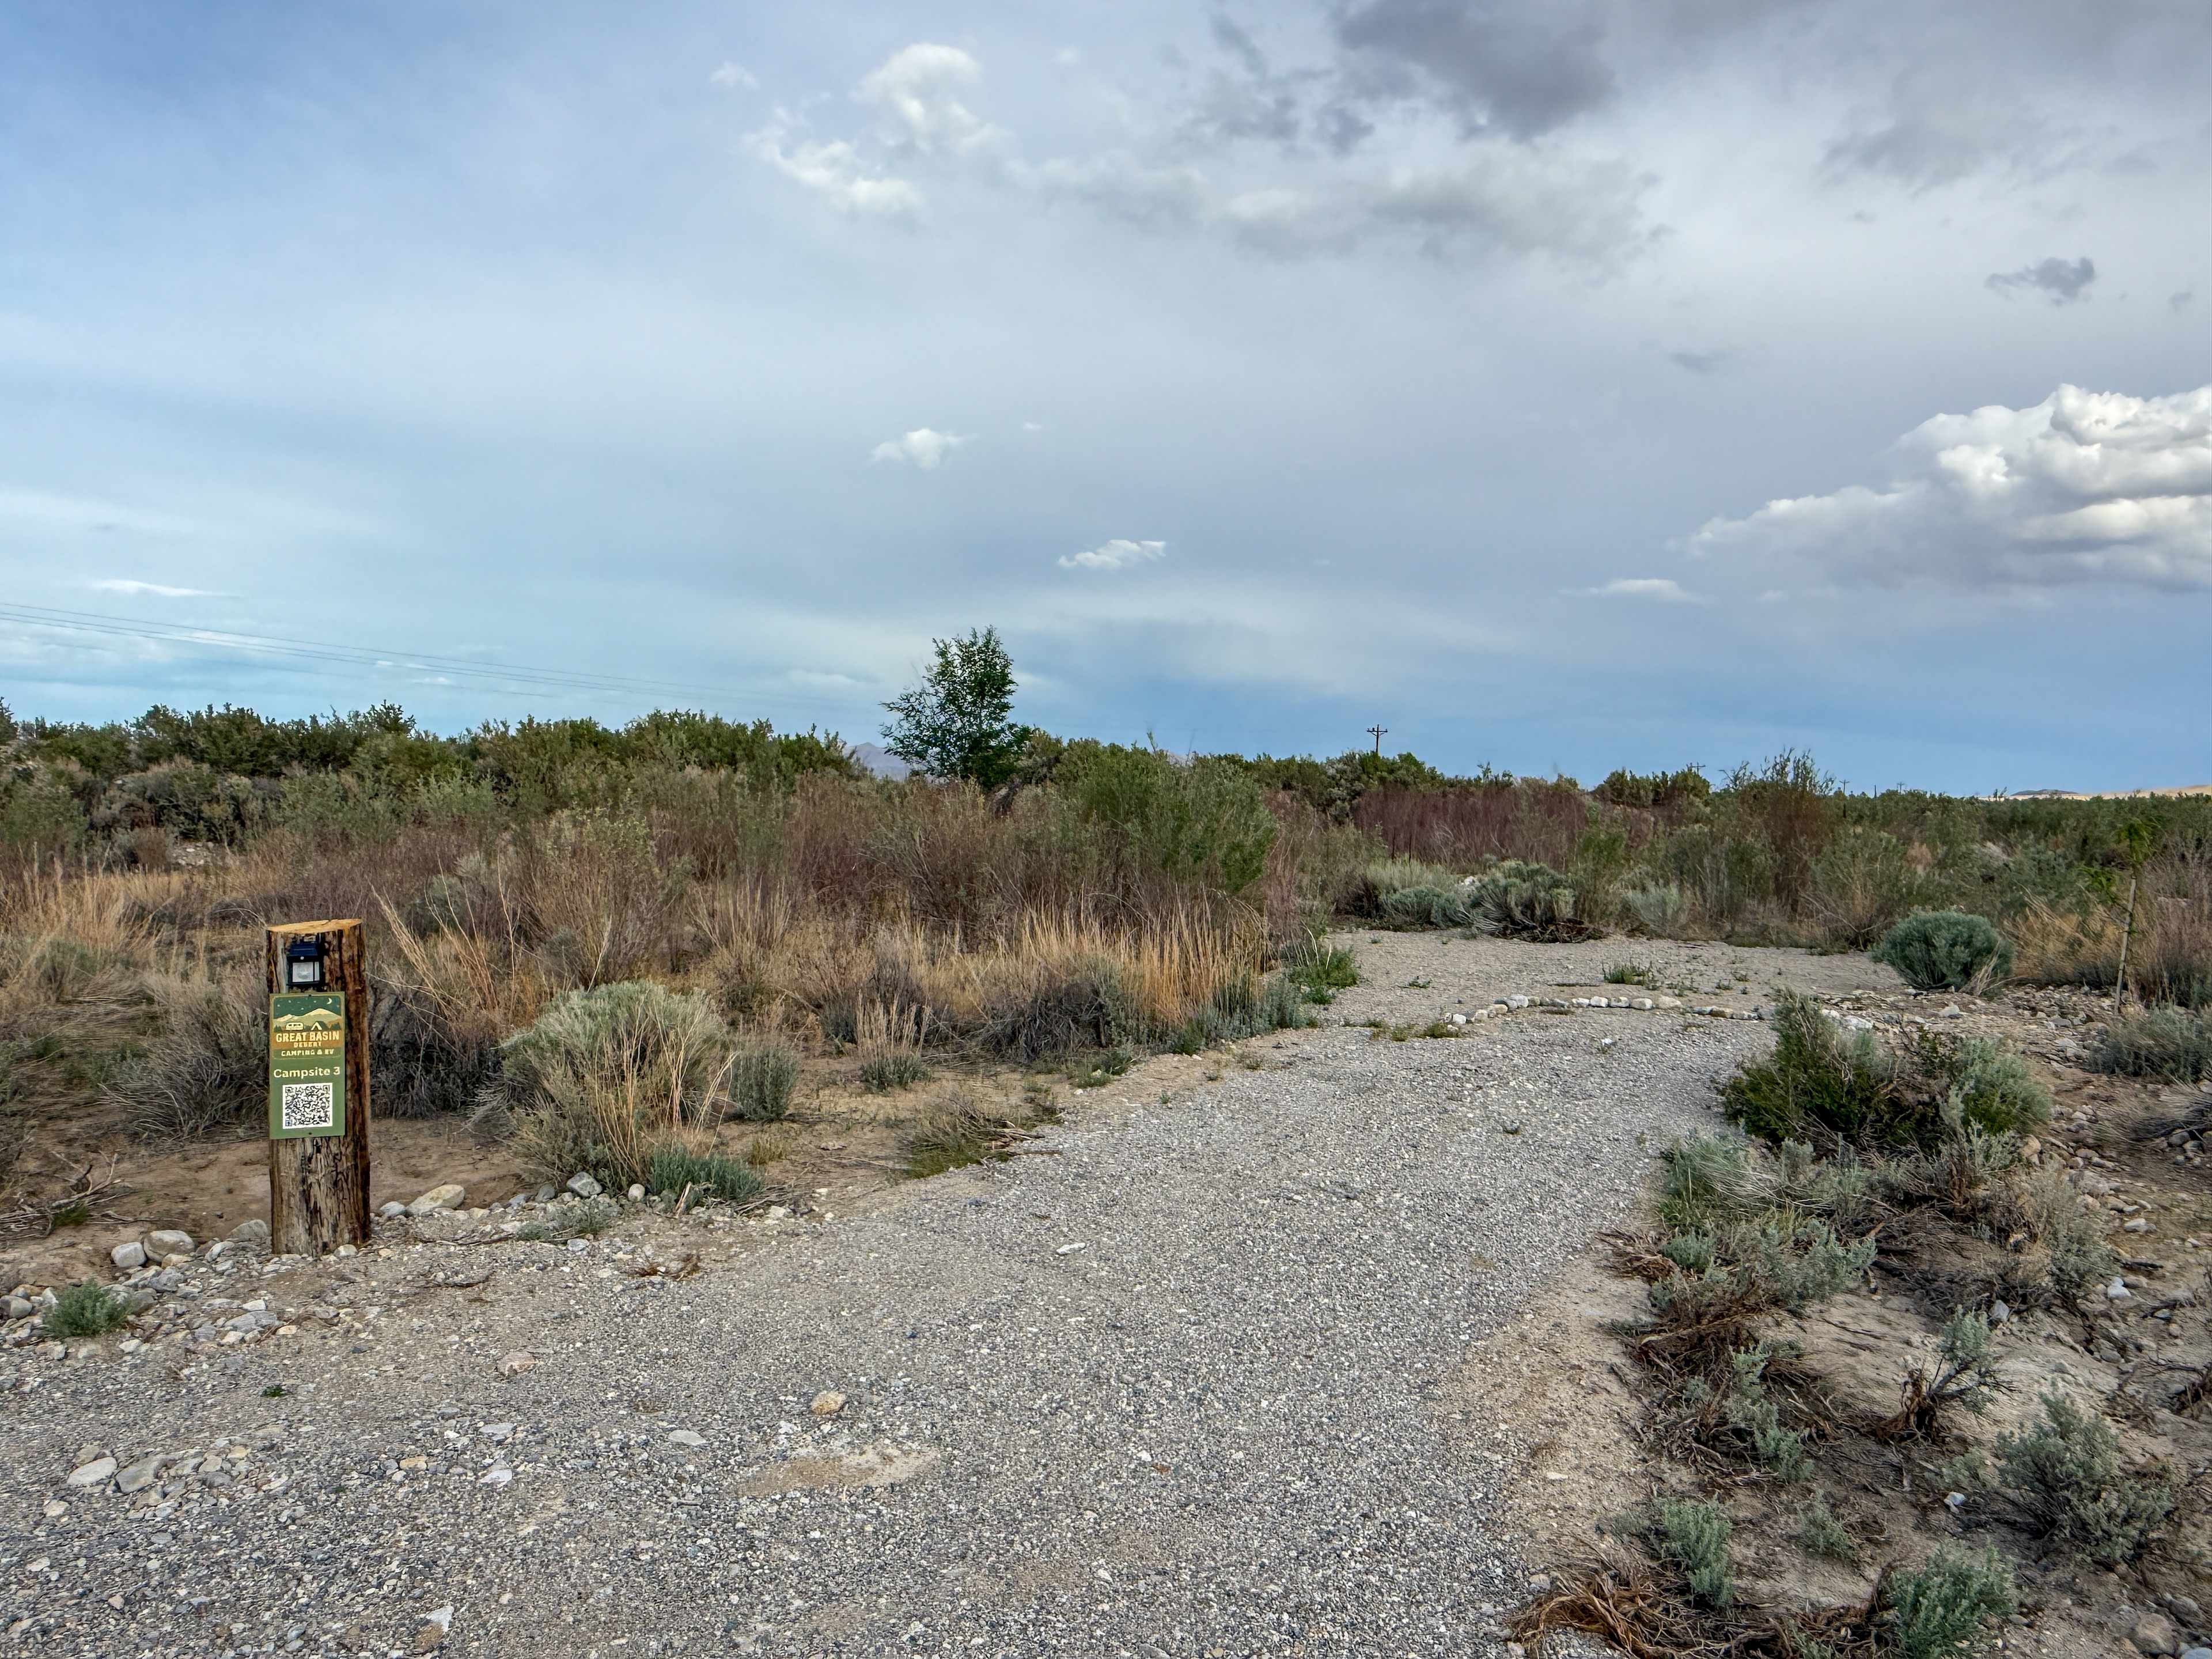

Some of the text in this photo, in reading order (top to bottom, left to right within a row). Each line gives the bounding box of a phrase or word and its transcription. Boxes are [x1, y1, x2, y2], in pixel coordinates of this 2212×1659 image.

[276, 1031, 339, 1042] GREAT BASIN
[274, 1066, 340, 1079] Campsite 3
